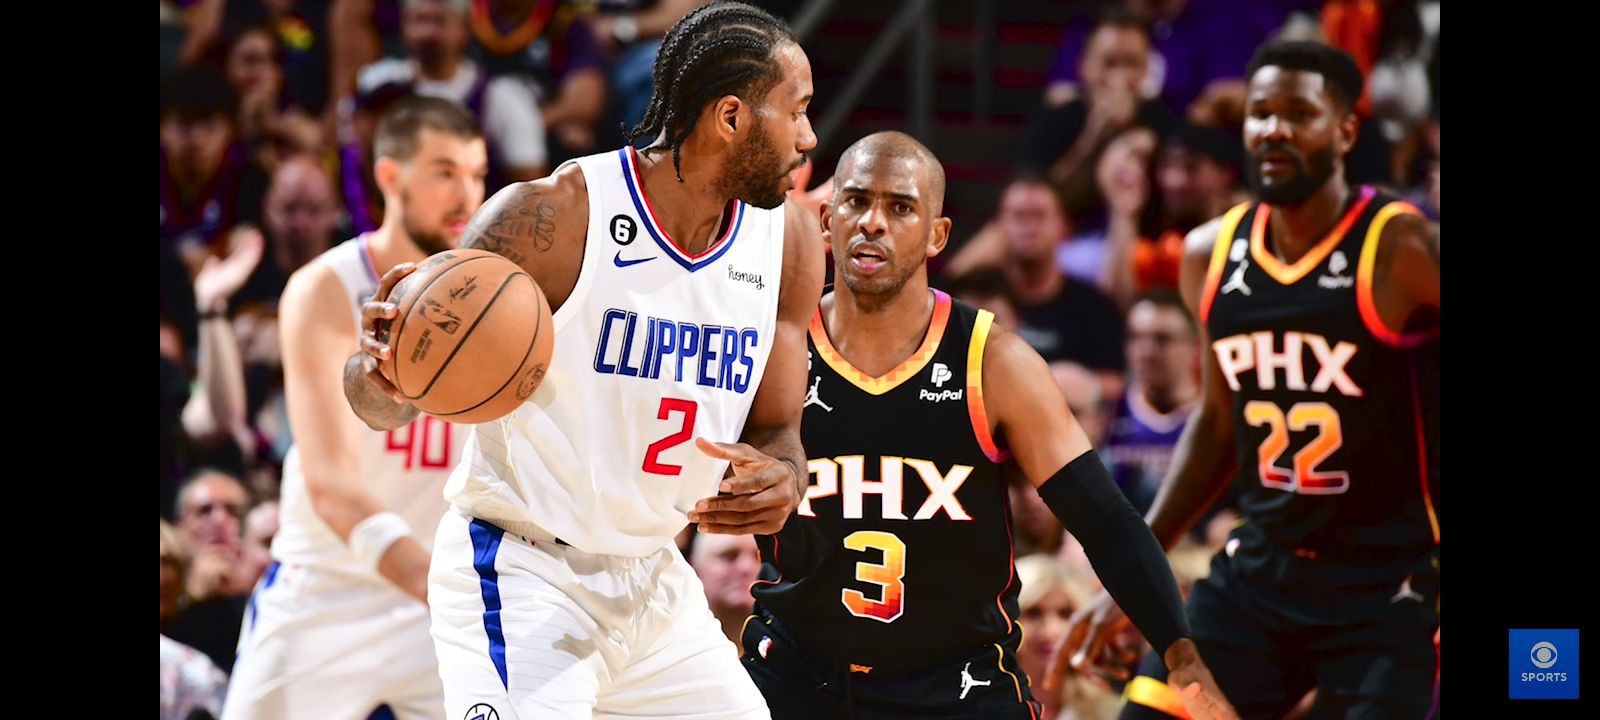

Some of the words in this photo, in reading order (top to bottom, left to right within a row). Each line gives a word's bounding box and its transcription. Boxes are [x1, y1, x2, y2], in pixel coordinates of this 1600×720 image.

[614, 218, 631, 243] 6
[727, 263, 765, 291] honey
[593, 308, 758, 394] CLIPPERS
[1212, 330, 1364, 397] PHX
[919, 389, 963, 402] PayPal
[385, 415, 451, 470] 40
[642, 397, 698, 476] 2
[1243, 400, 1349, 494] 22
[796, 455, 975, 521] PHX
[842, 531, 906, 623] 3
